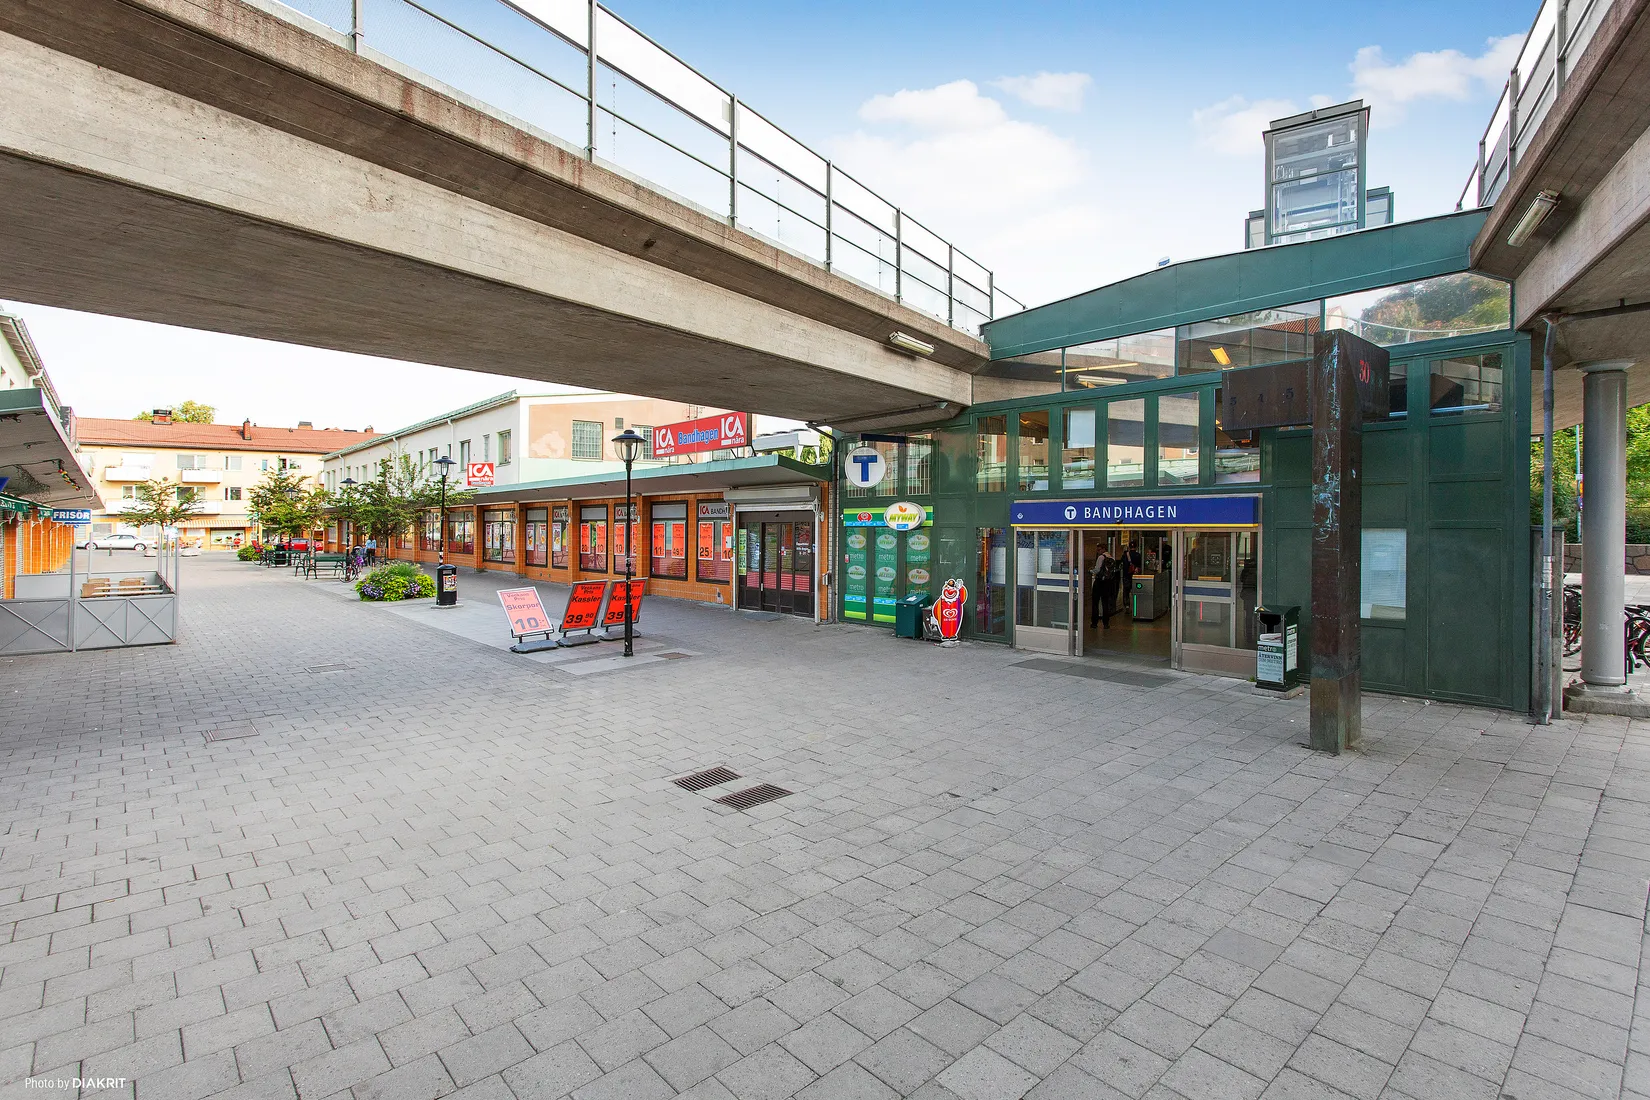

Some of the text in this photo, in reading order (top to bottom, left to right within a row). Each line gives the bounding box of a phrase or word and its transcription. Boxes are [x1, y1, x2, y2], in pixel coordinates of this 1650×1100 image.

[721, 415, 744, 438] ICA
[656, 428, 674, 448] ICA
[678, 428, 719, 445] Bandhagen
[731, 436, 744, 445] nära
[469, 464, 493, 476] ICA
[852, 454, 877, 482] T
[53, 510, 90, 519] FRISÖR
[700, 505, 728, 515] ICA BANDH
[1084, 505, 1177, 519] BANDHAGEN
[889, 513, 919, 522] MYWAY
[566, 614, 583, 624] 39
[607, 612, 624, 620] 39
